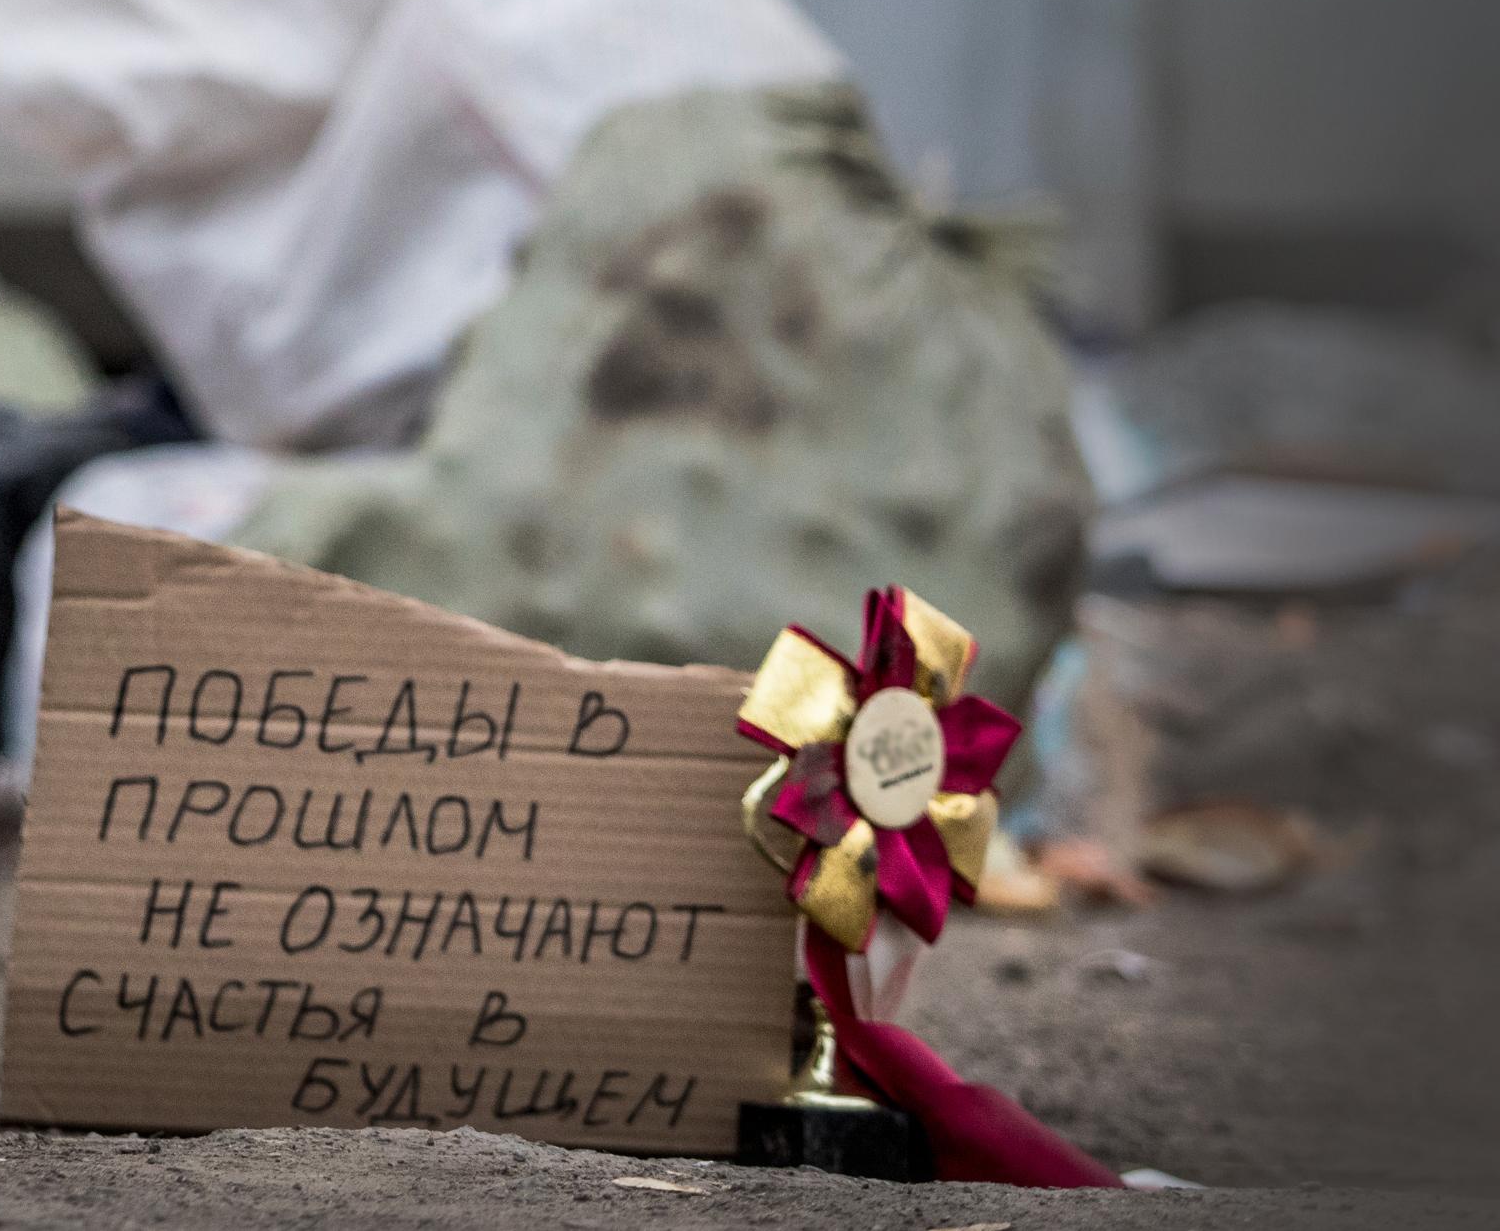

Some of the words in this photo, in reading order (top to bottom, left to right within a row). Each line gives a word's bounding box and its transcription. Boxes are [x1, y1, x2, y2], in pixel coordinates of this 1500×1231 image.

[109, 664, 521, 765] ПОБЕДЫ
[98, 775, 539, 860] ПРОШЛОМ
[139, 878, 242, 949] НЕ
[278, 885, 727, 964] ОЗНАЧАЮТ
[57, 970, 384, 1041] СЧАСТЬЯ
[290, 1057, 697, 1128] БУДУЩЕМ
